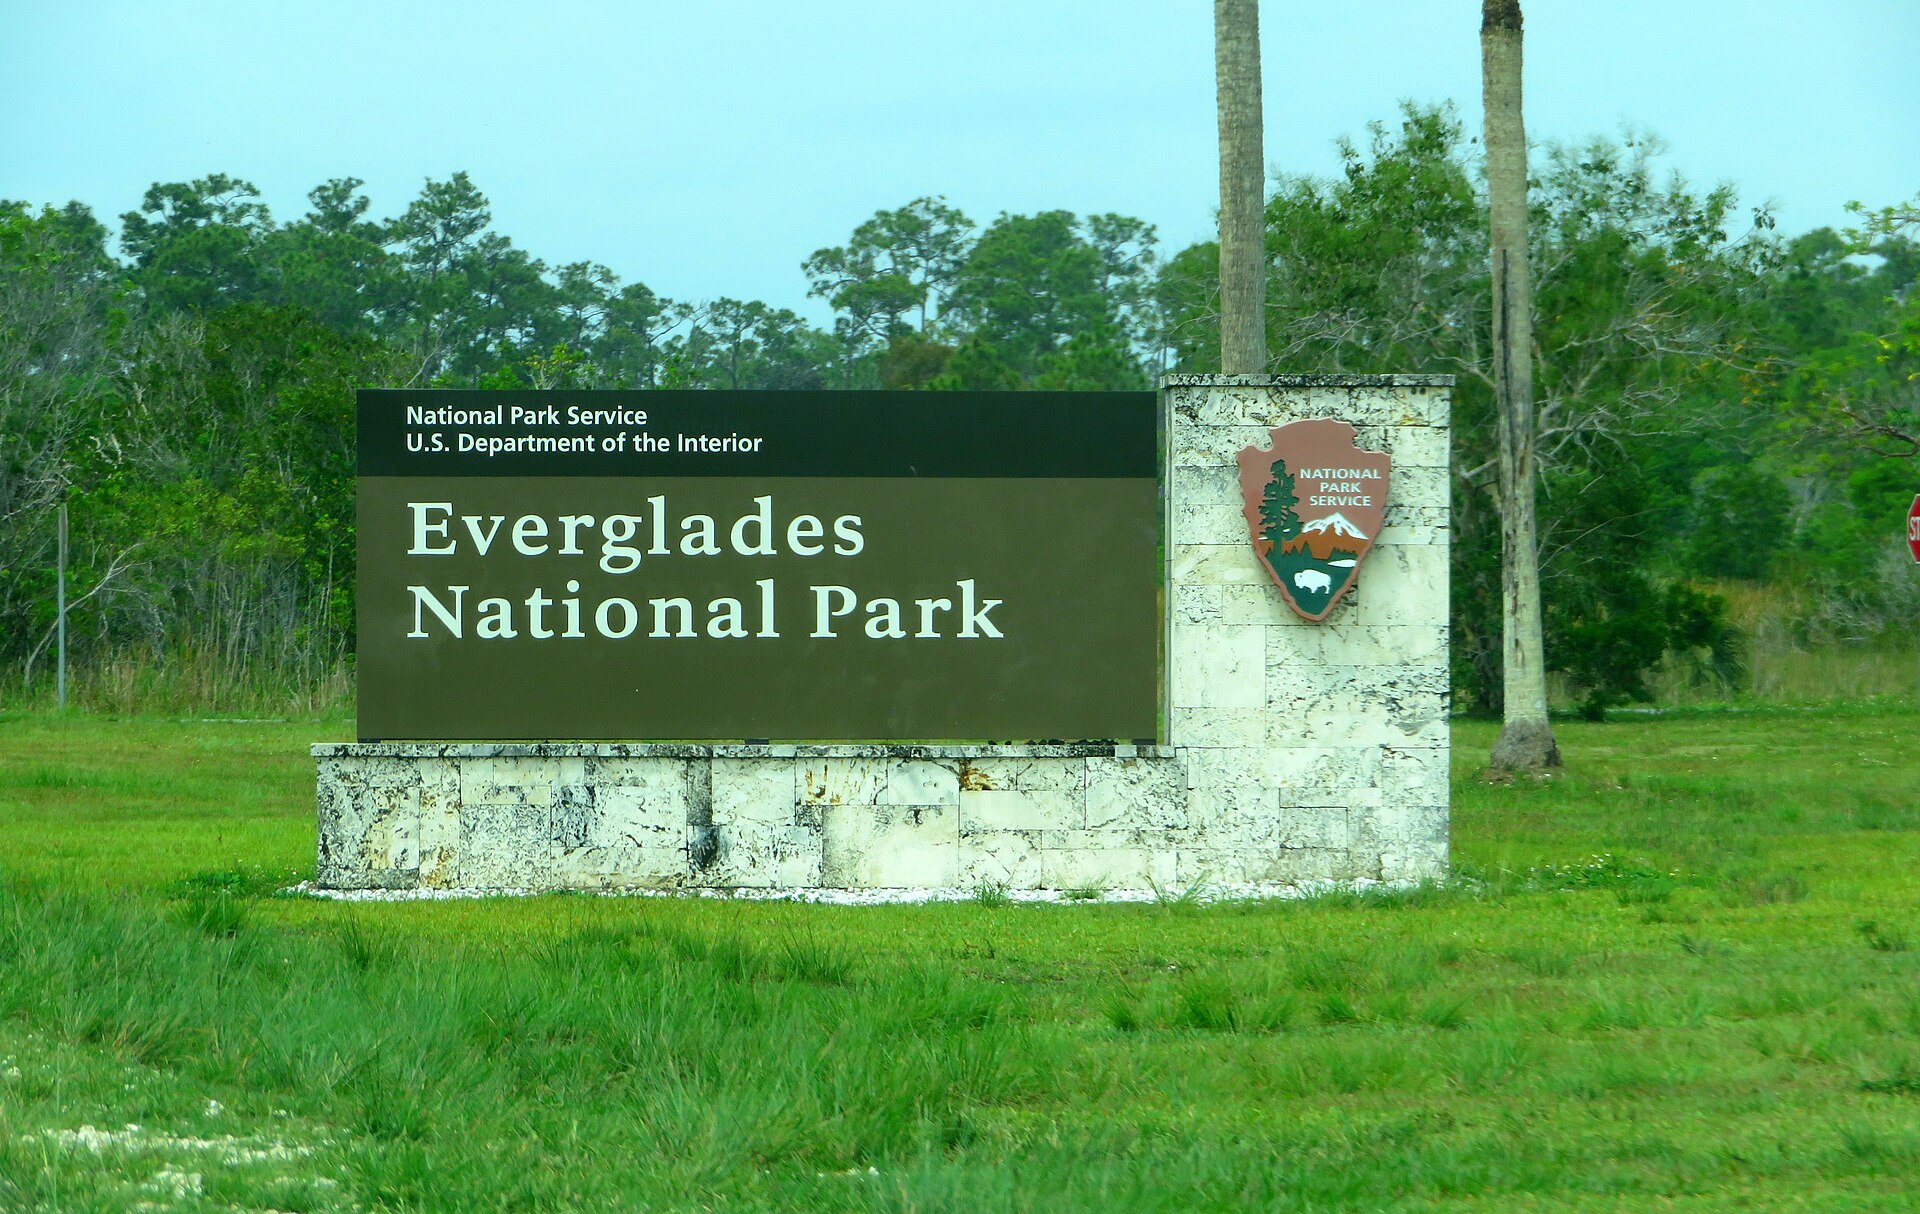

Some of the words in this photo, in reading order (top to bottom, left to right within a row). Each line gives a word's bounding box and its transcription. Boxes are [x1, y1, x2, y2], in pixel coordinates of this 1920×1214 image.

[407, 404, 503, 425] National
[511, 404, 561, 425] Park
[567, 405, 648, 425] Service
[407, 432, 450, 452] U.S.
[458, 433, 596, 457] Department
[601, 431, 627, 452] of
[632, 431, 671, 452] the
[678, 432, 763, 453] Interior
[1299, 468, 1382, 480] NATIONAL
[1319, 481, 1362, 493] PARK
[1309, 495, 1372, 507] SERVICE
[407, 494, 864, 574] Everglades
[406, 578, 780, 639] National
[809, 578, 1004, 639] Park
